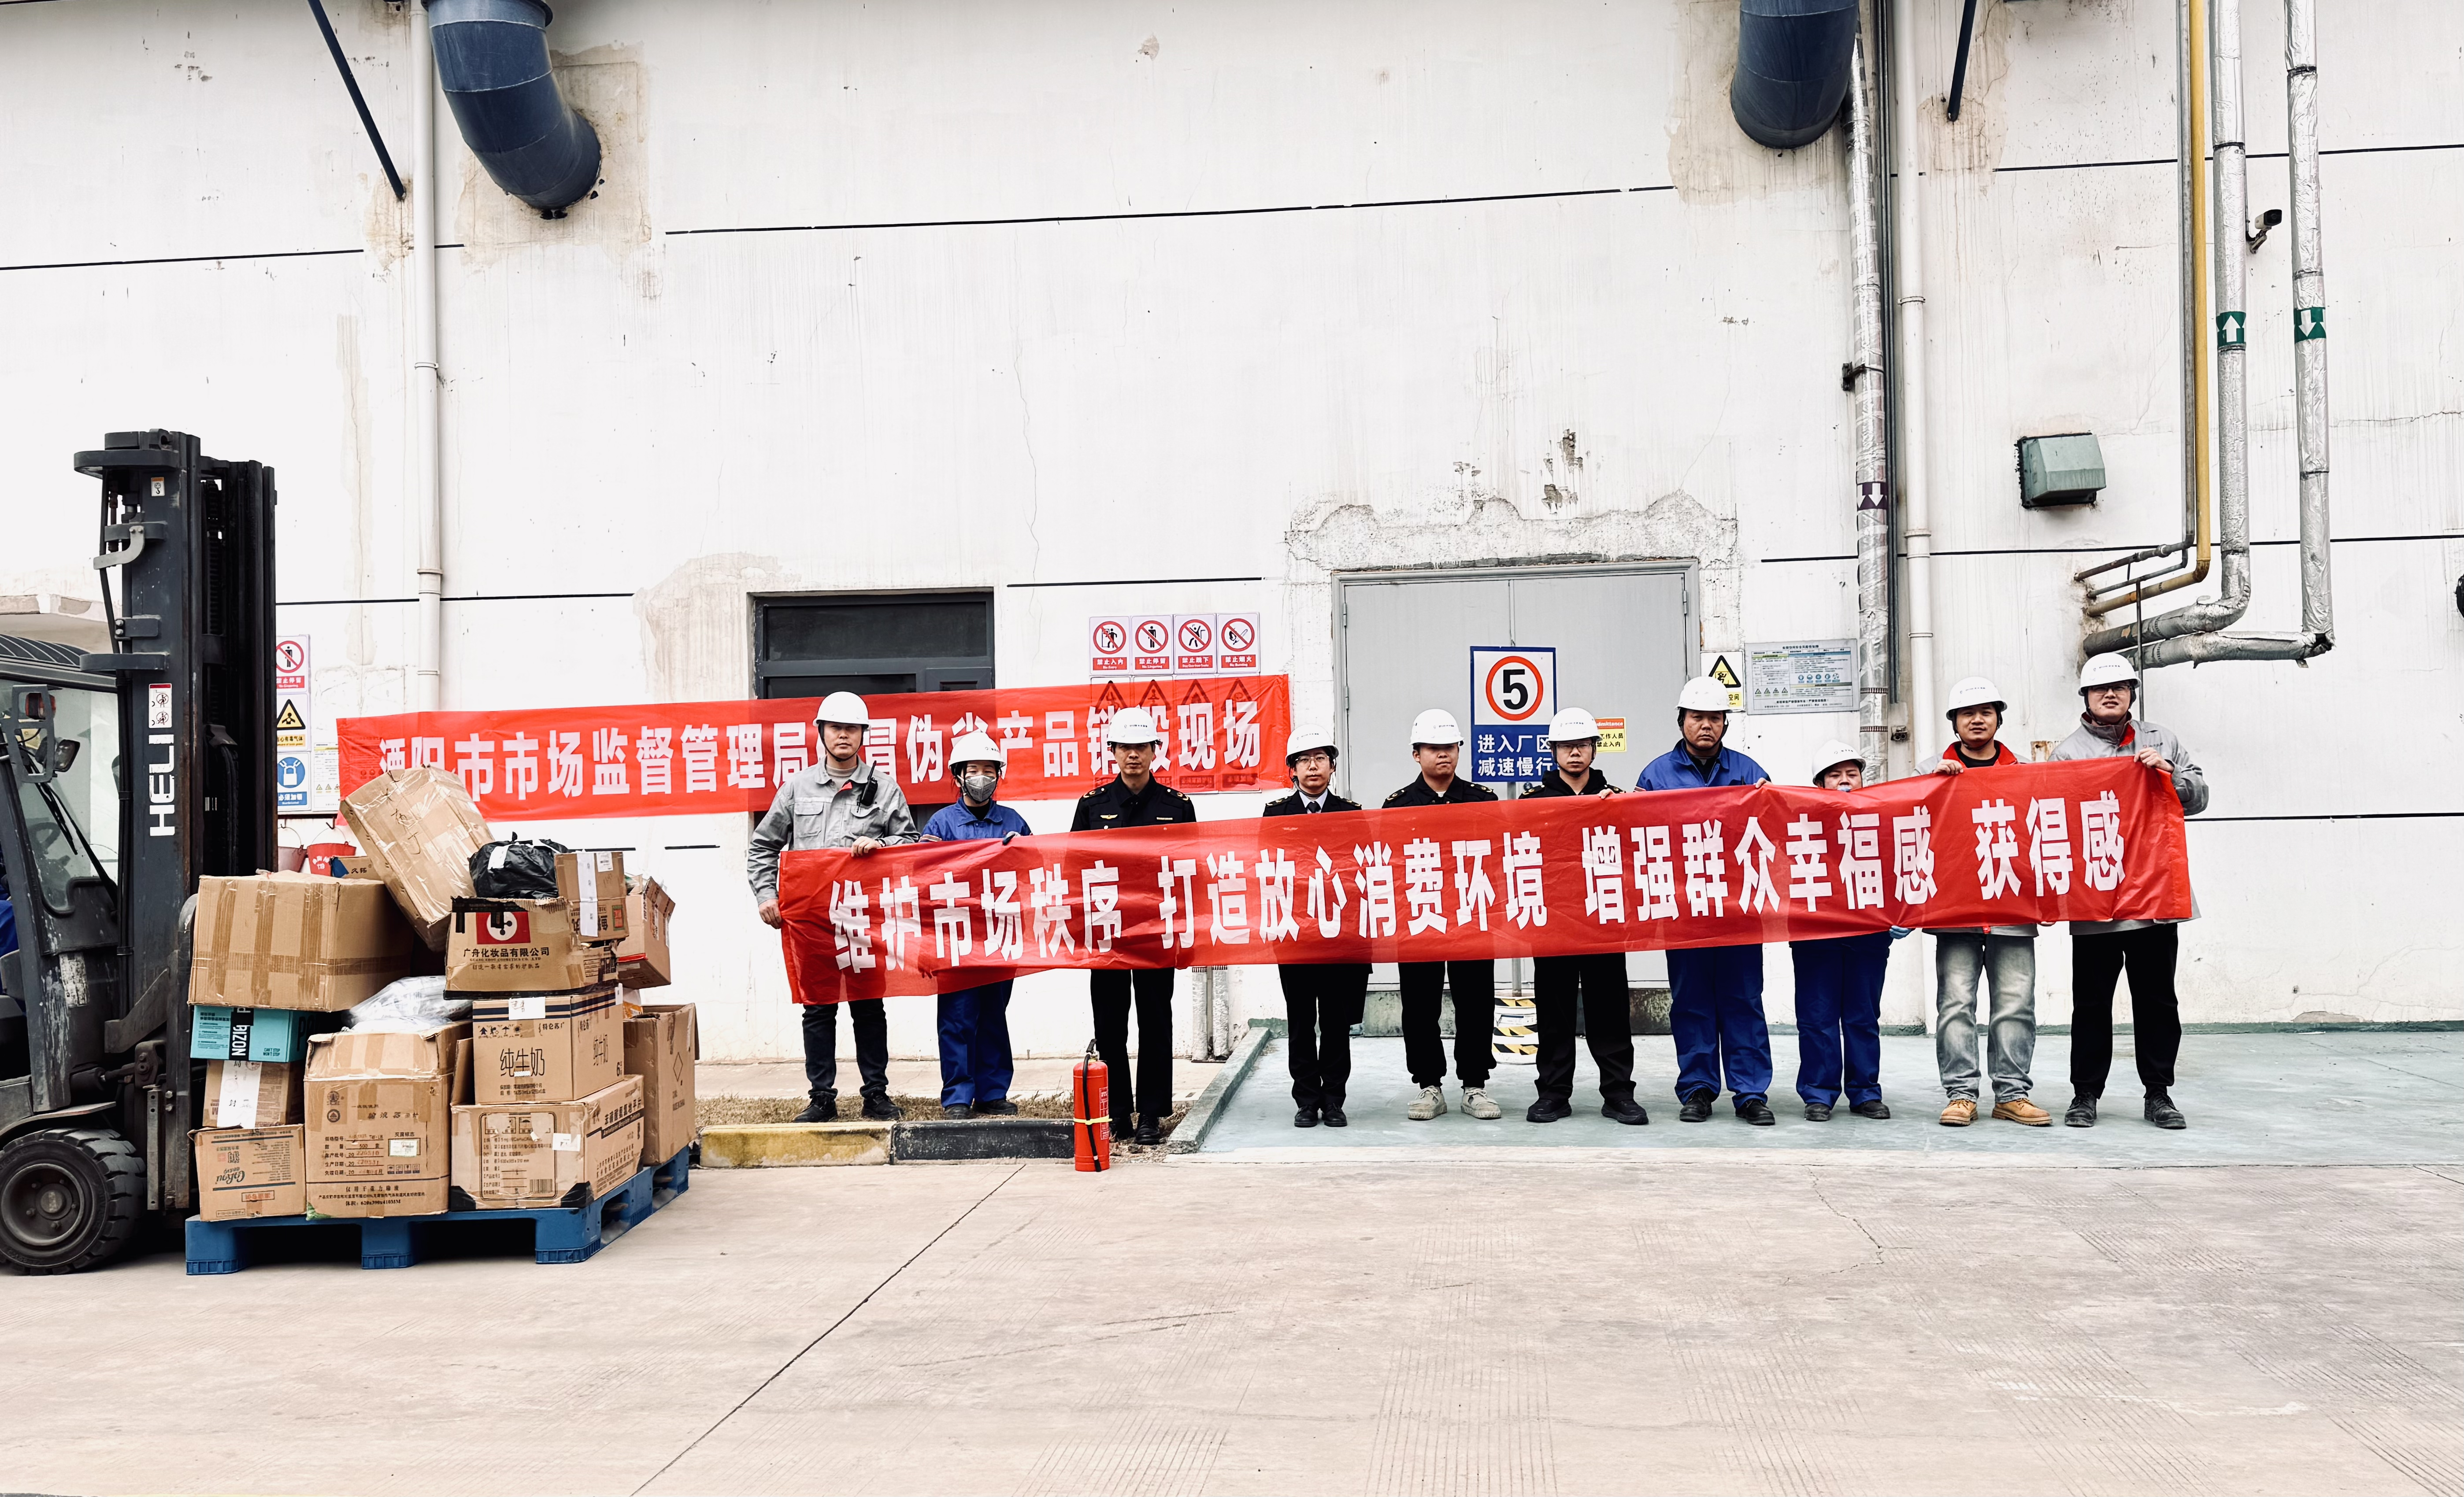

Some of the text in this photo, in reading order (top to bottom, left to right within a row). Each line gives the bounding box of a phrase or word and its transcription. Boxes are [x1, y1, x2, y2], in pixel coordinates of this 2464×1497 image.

[1503, 669, 1528, 710] 5
[379, 699, 1260, 802] 市市场监督管理局冒伪产品销现场
[1478, 734, 1552, 753] 进入厂区
[1478, 757, 1553, 776] 减速慢行
[149, 734, 175, 836] HELI
[829, 790, 2126, 973] 维护市场秩序 打造放心消费环境 增强群众幸福感 获得感
[463, 947, 549, 957] 广舟化妆品有限公司
[500, 1047, 545, 1077] 纯牛奶
